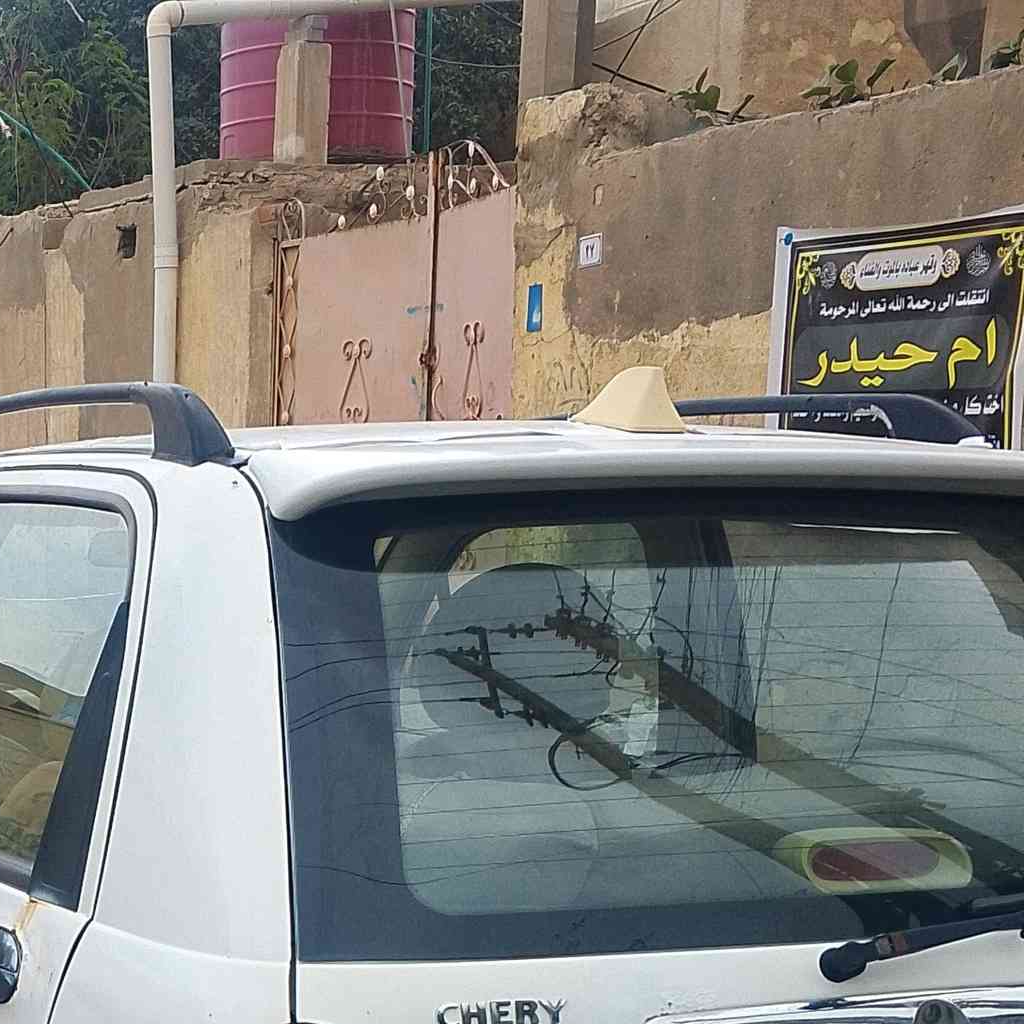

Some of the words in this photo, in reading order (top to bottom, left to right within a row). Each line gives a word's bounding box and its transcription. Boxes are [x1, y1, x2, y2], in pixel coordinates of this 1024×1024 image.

[888, 294, 905, 312] الله
[907, 295, 936, 313] رحمة
[955, 288, 990, 307] انتقلت
[819, 301, 859, 320] المرحومة
[797, 336, 938, 387] حيدر
[947, 318, 997, 390] ام
